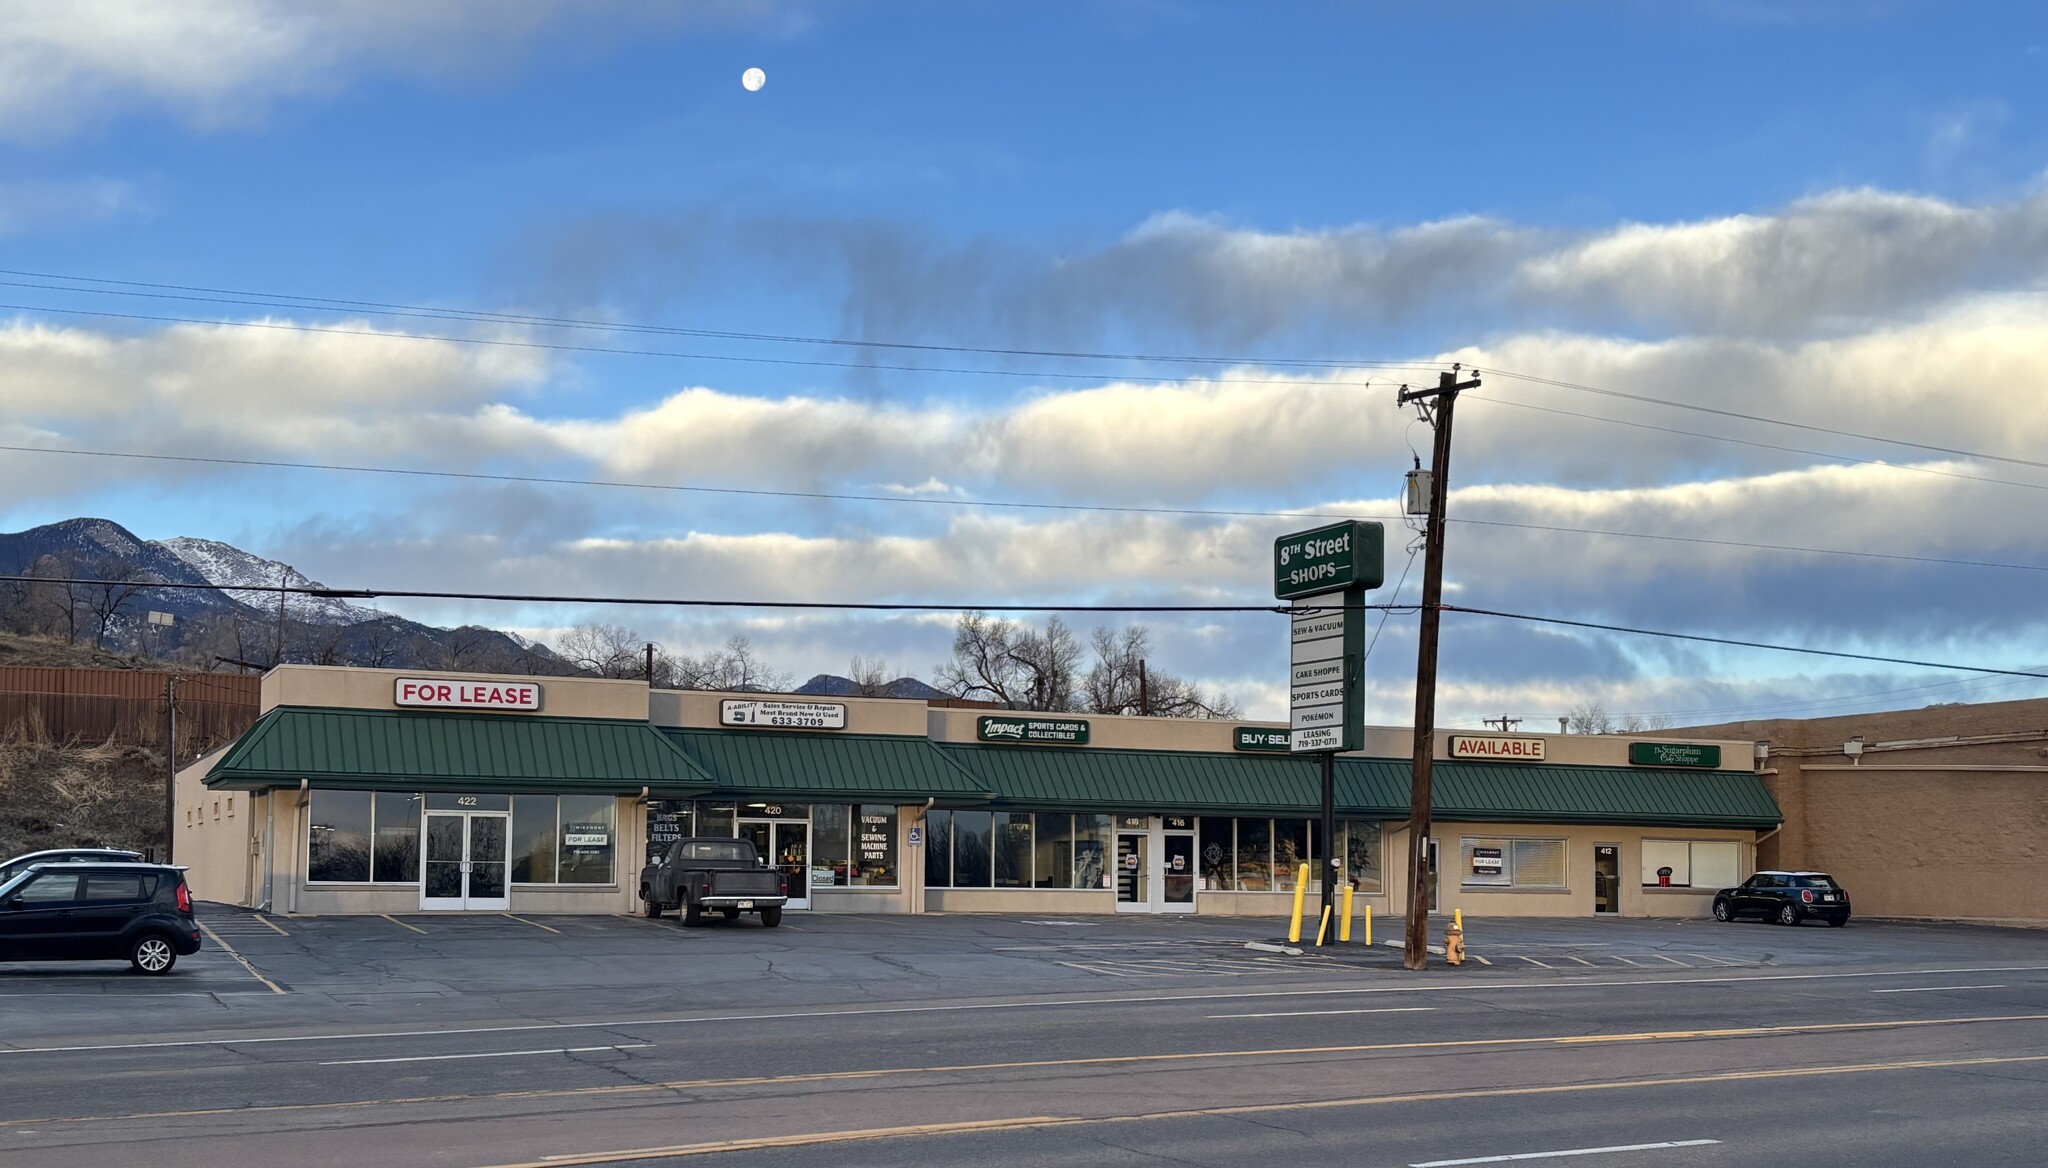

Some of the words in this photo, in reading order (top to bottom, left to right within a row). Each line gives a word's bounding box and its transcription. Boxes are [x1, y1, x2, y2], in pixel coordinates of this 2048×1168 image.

[1280, 543, 1301, 566] 8TH
[1304, 532, 1350, 560] Street
[1290, 562, 1336, 585] SHOPS
[1293, 627, 1308, 636] SEW
[1308, 625, 1313, 633] &
[1314, 621, 1343, 632] VACUUM
[1295, 670, 1313, 679] CAKE
[1313, 666, 1341, 677] SHOPPE
[403, 684, 452, 702] FOR
[460, 686, 532, 704] LEASE
[1291, 691, 1320, 702] SPORTS
[1320, 688, 1344, 698] CARDS
[771, 717, 824, 726] 633-3709
[1301, 712, 1334, 722] POKÉMON
[984, 719, 1025, 735] Impact
[1028, 722, 1055, 730] SPORTS
[1055, 723, 1079, 731] CARDS
[1028, 730, 1076, 740] COLLECTIBLES
[1303, 729, 1332, 739] LEASING
[1297, 737, 1338, 748] 719-337-0711
[1458, 740, 1541, 756] AVAILABLE
[1661, 744, 1701, 757] Sugarplum
[1675, 754, 1699, 764] Shoppe
[457, 796, 477, 806] 422
[764, 806, 782, 815] 420
[656, 813, 677, 822] BAGS
[861, 815, 887, 824] VACUUM
[1126, 817, 1139, 825] 418
[653, 823, 680, 832] BELTS
[861, 833, 887, 841] SEWING
[861, 842, 887, 851] MACHINE
[1601, 847, 1612, 855] 412
[864, 851, 883, 860] PARTS
[812, 874, 834, 883] Closed
